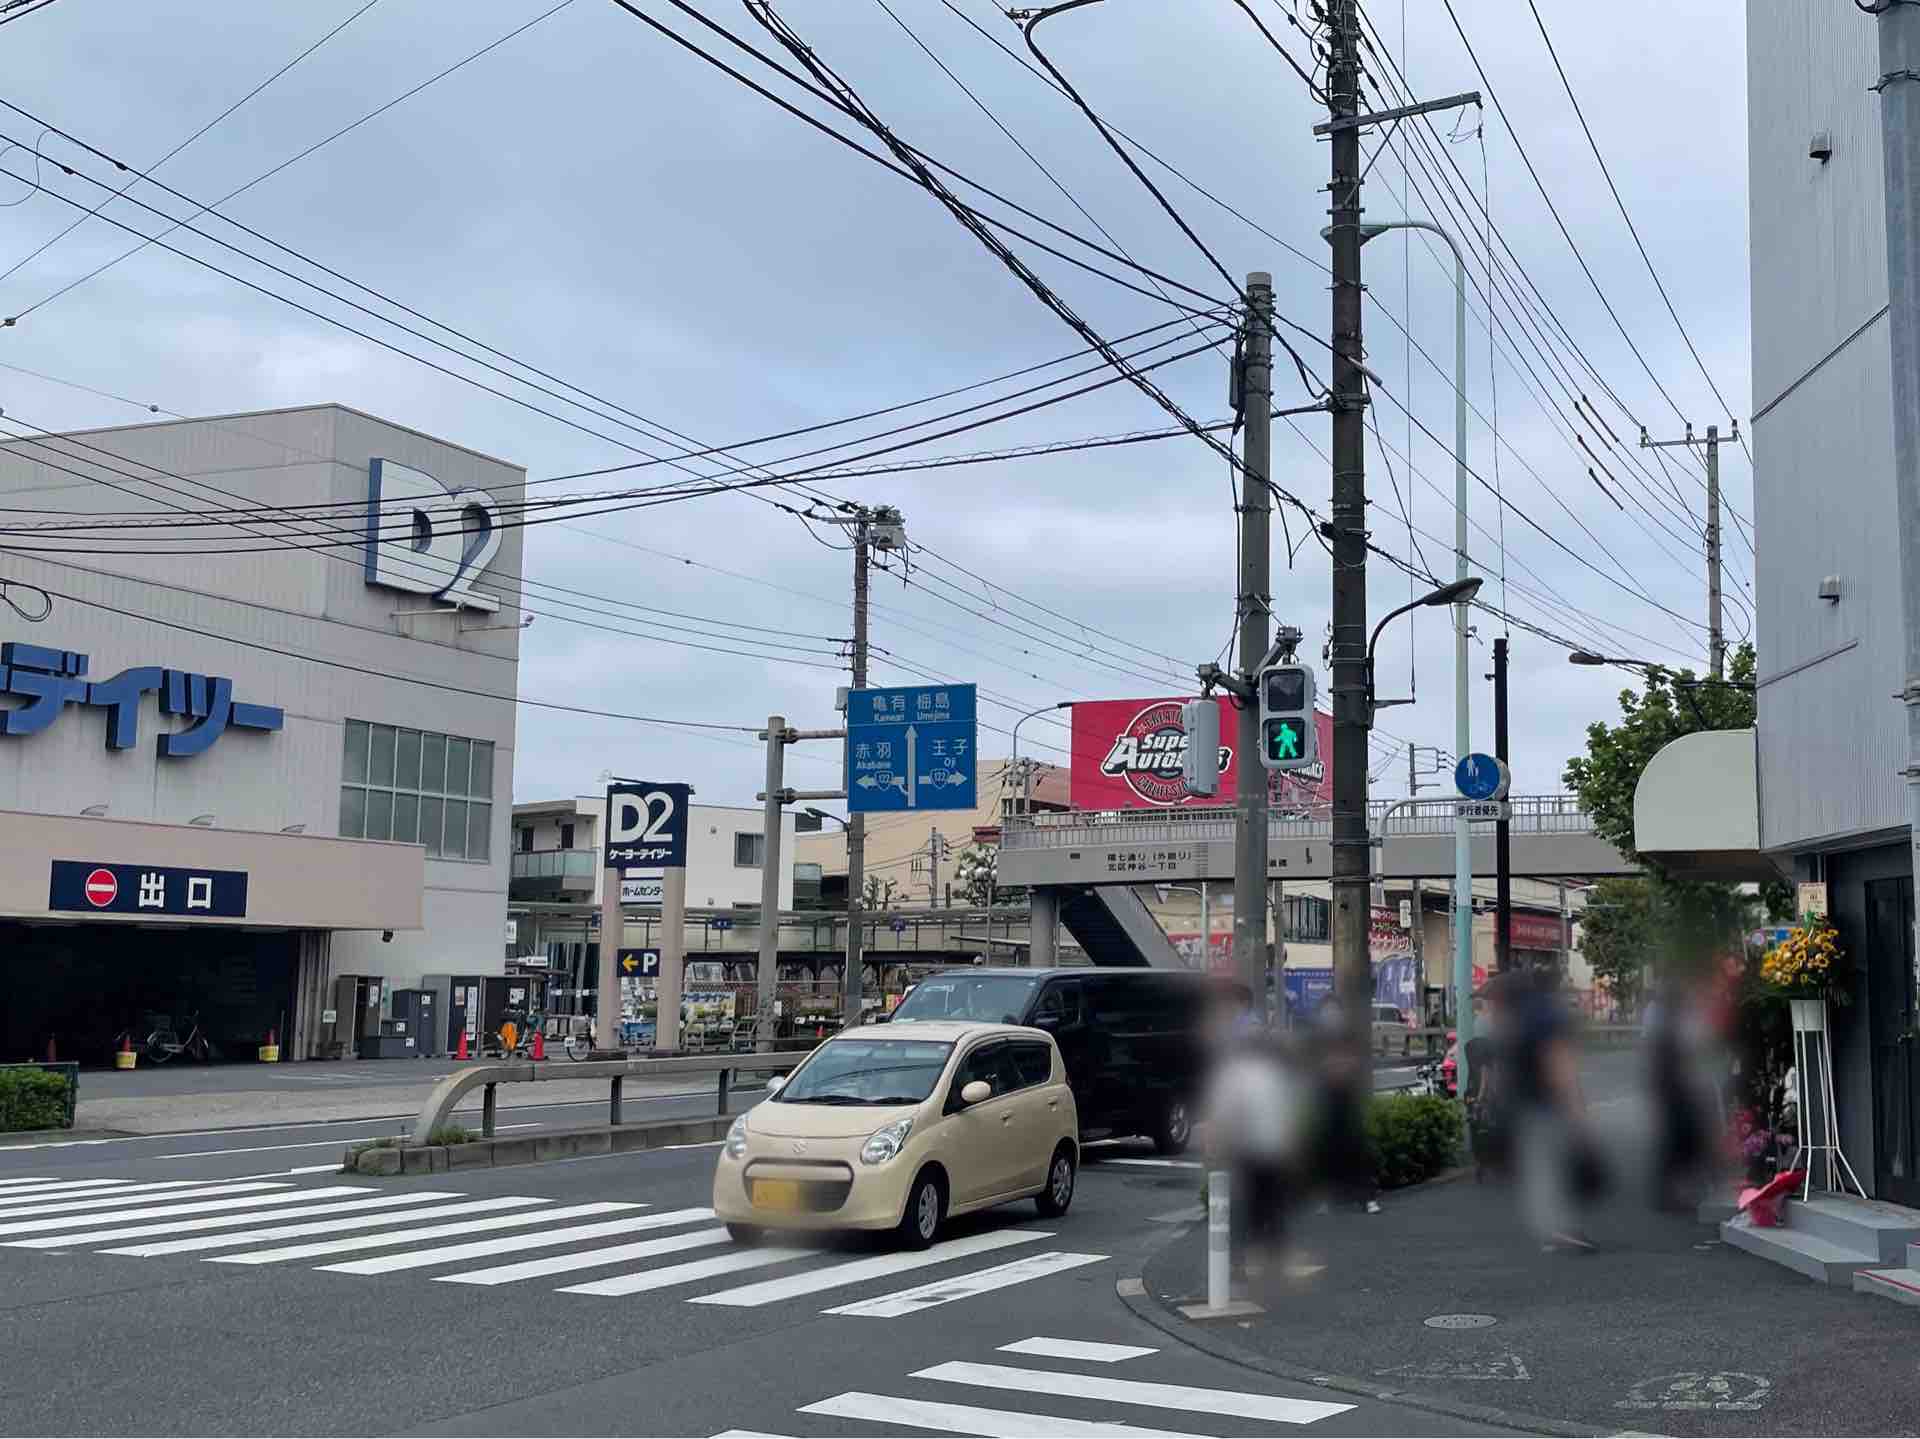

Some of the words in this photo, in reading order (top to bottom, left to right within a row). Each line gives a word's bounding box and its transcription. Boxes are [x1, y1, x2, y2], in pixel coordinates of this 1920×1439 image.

[366, 458, 503, 613] D2
[0, 641, 284, 757] デイツー
[855, 742, 891, 759] 赤羽
[932, 739, 968, 756] 王子
[1141, 733, 1189, 750] Supe
[610, 792, 674, 843] D2
[138, 872, 213, 909] 出口
[643, 953, 658, 973] P
